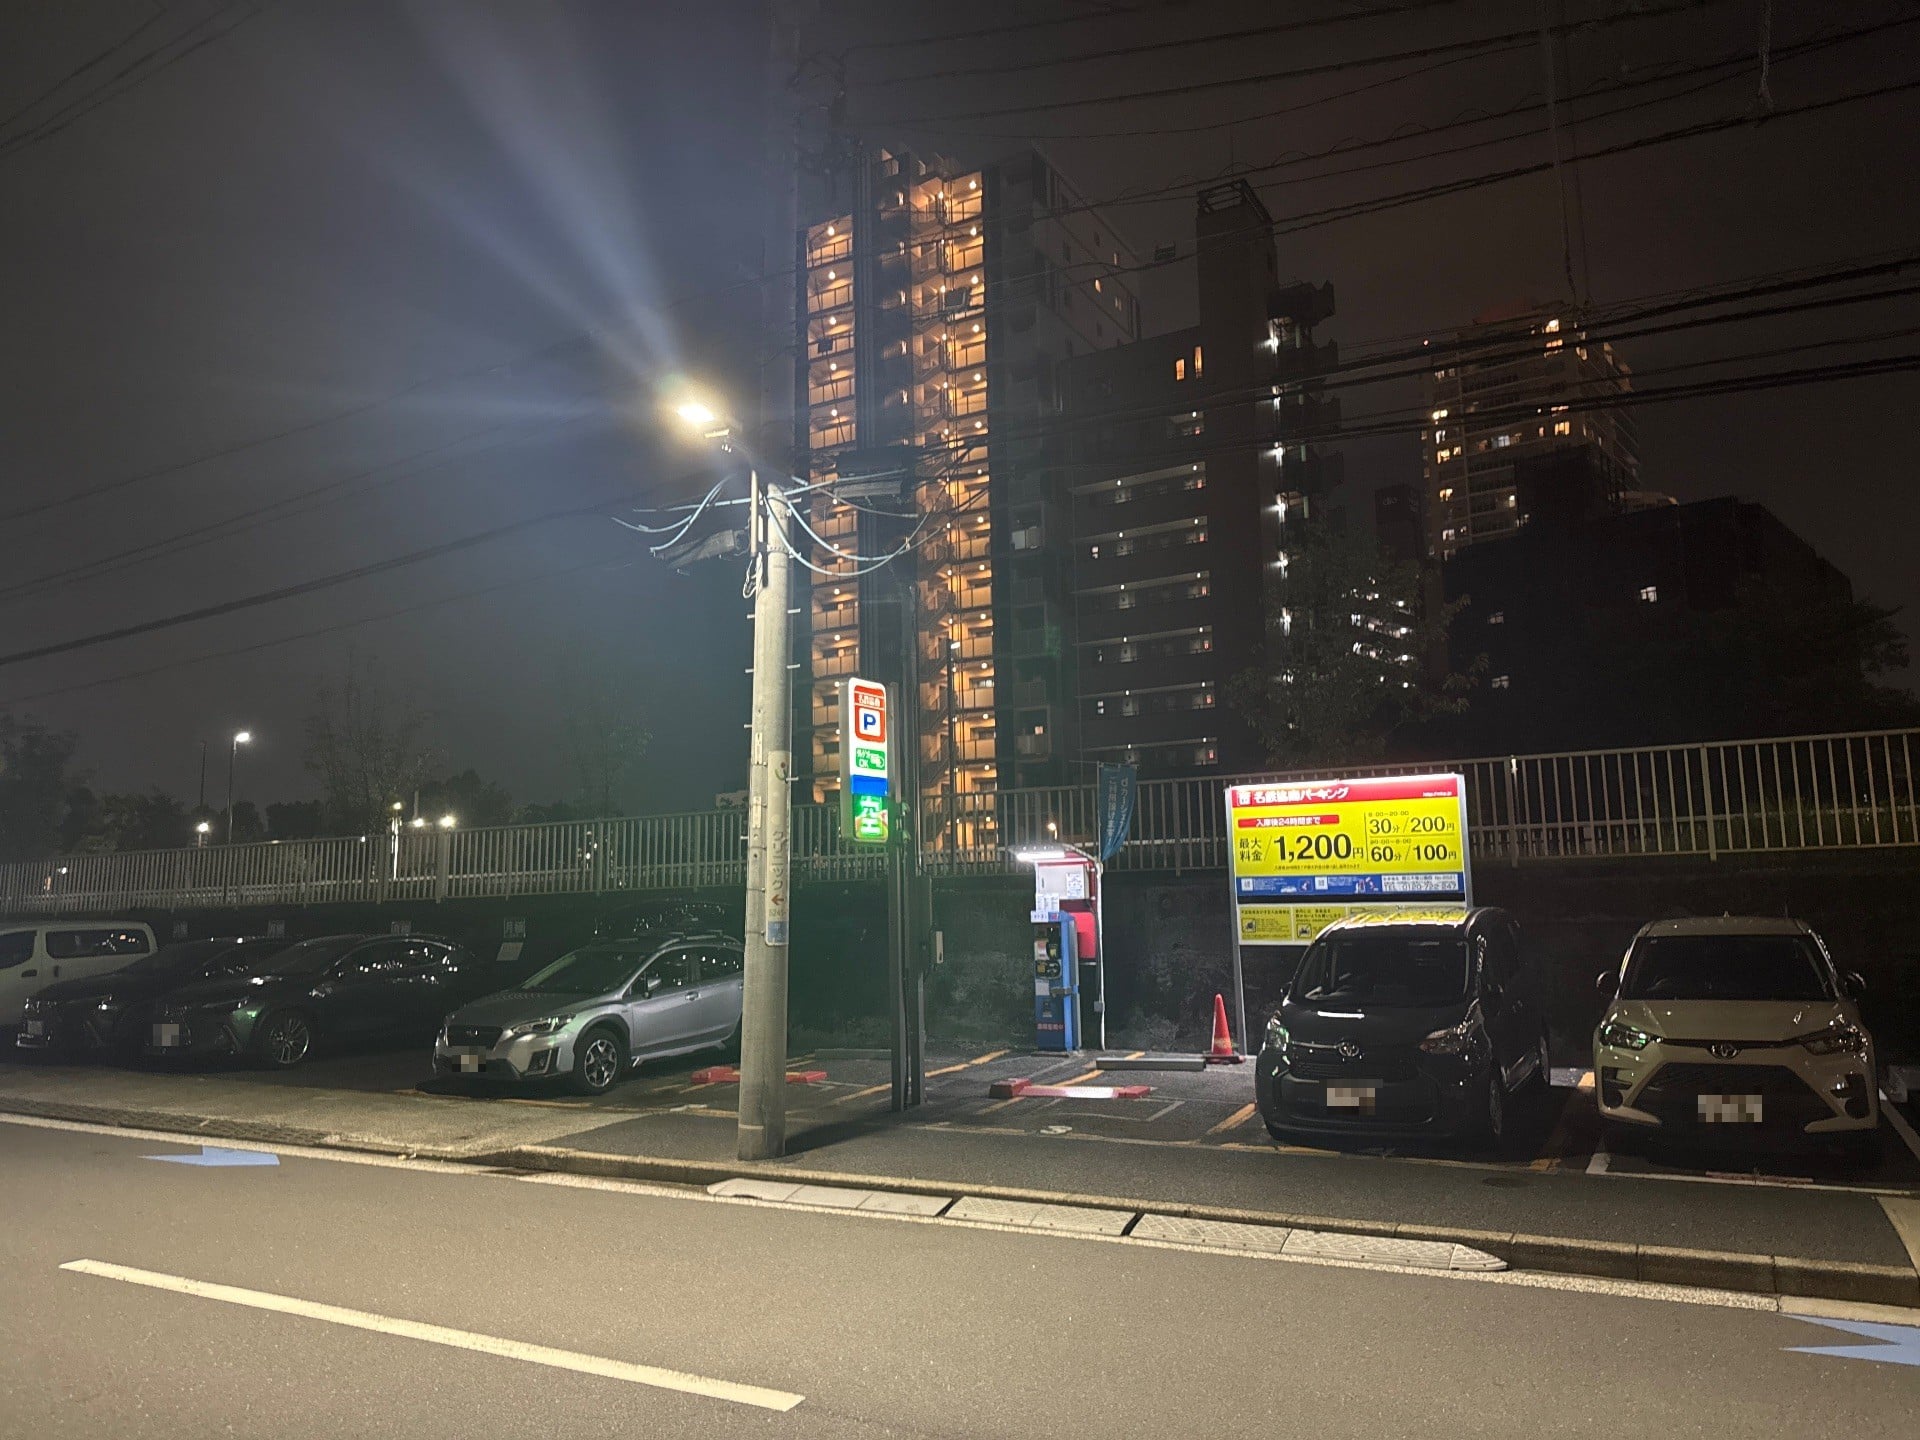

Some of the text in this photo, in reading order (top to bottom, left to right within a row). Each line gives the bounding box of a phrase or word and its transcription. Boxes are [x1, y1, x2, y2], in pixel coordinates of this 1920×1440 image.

[864, 713, 876, 730] P
[1239, 837, 1262, 849] 最大
[1240, 850, 1263, 862] 料金
